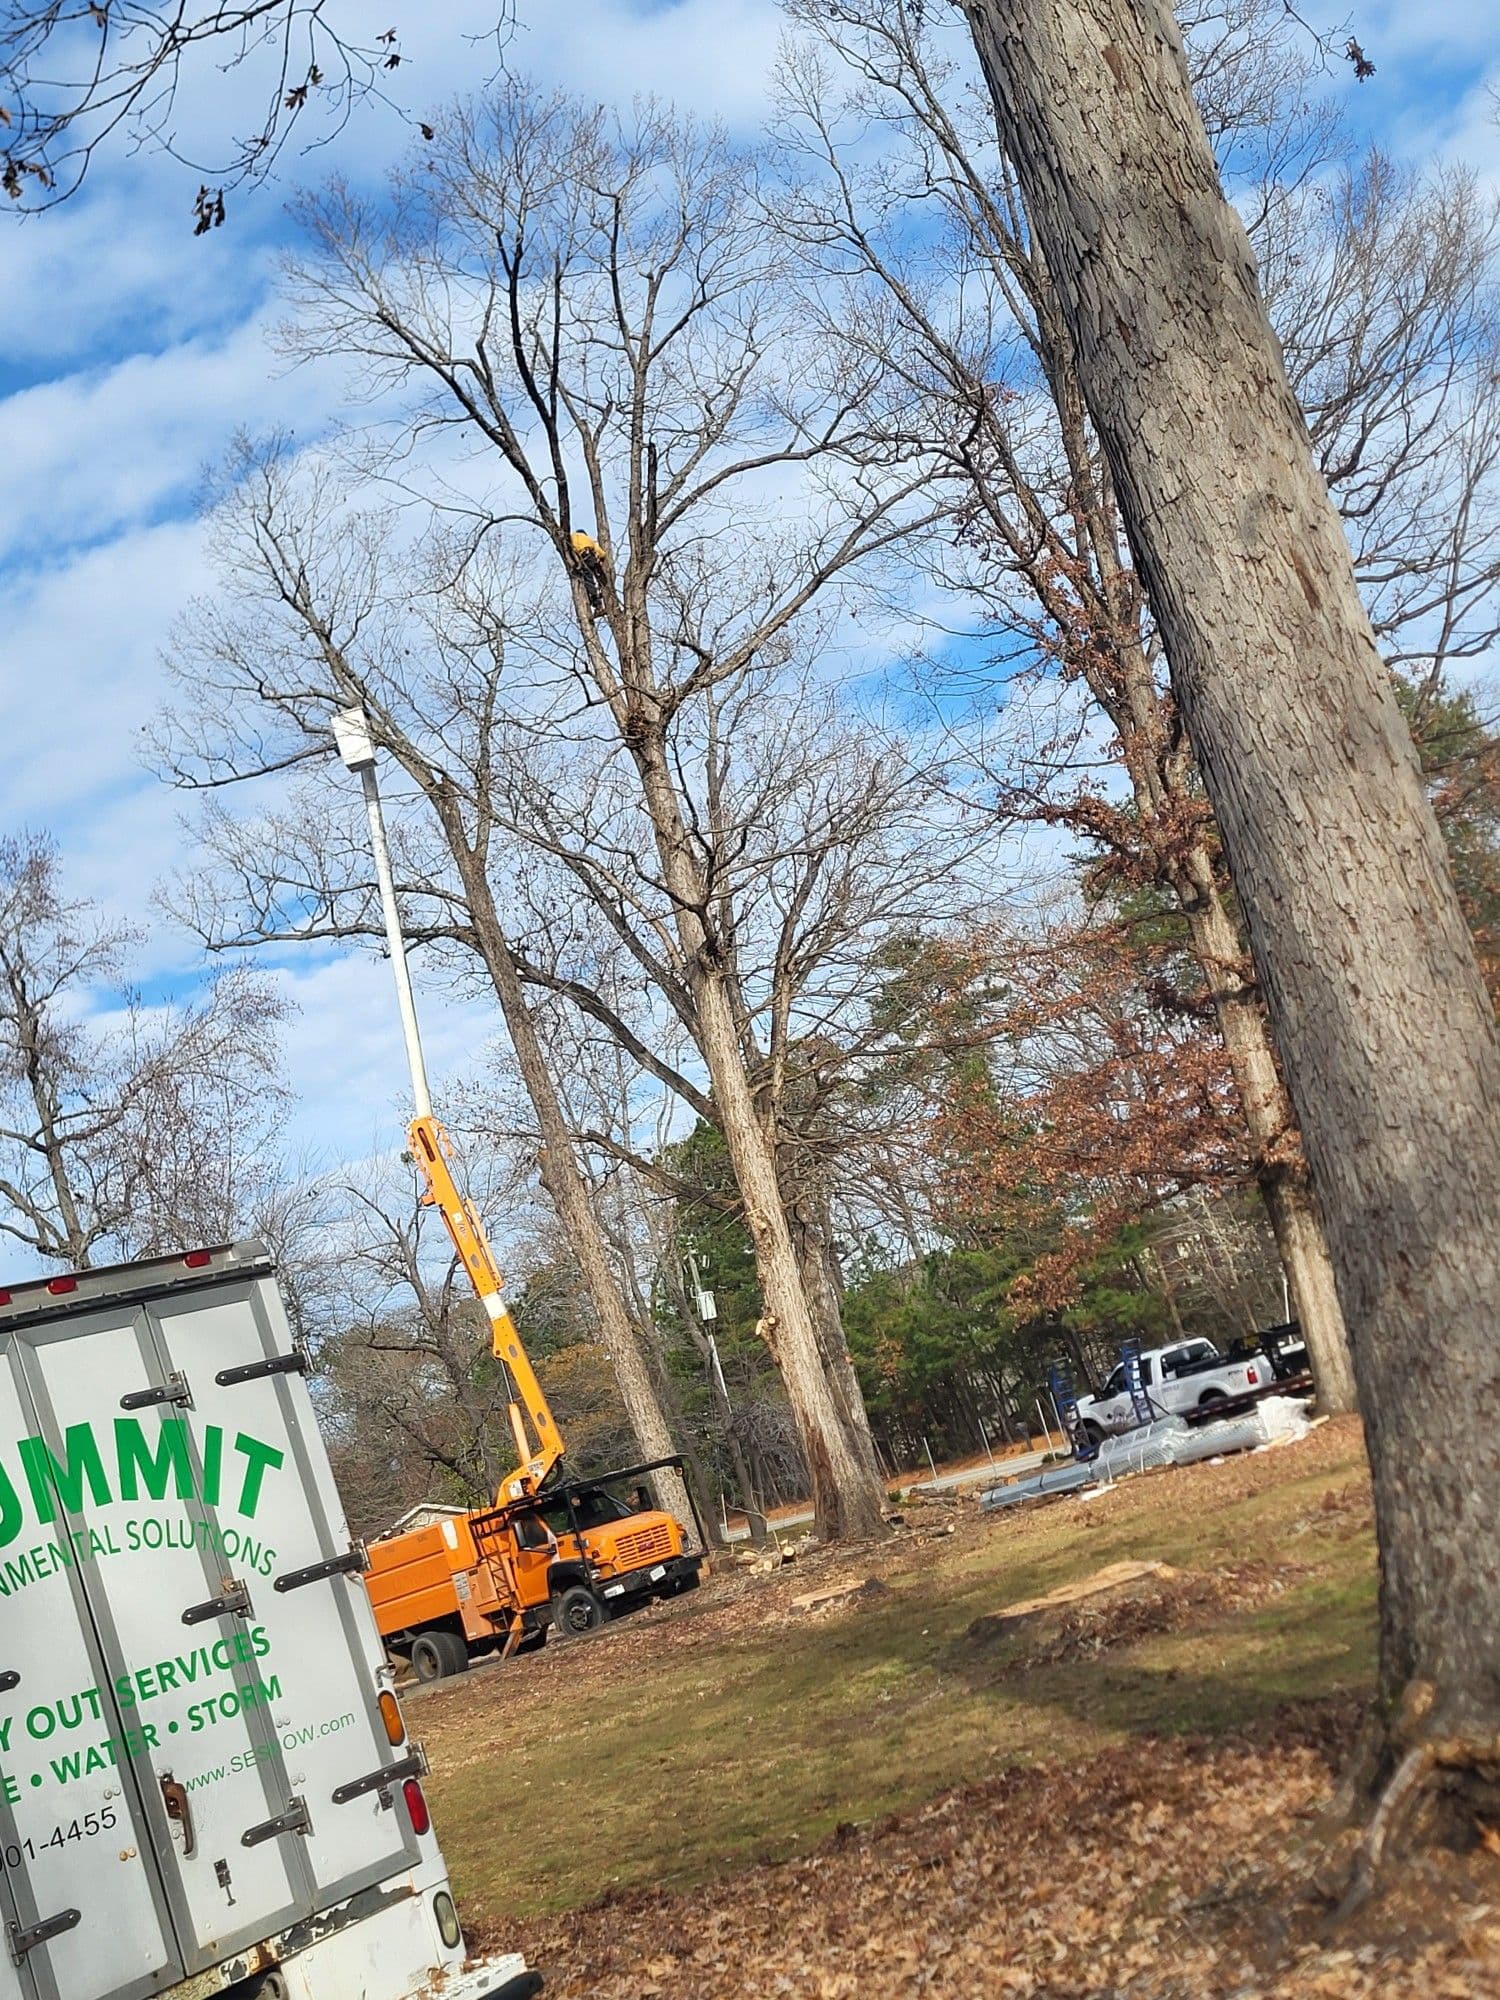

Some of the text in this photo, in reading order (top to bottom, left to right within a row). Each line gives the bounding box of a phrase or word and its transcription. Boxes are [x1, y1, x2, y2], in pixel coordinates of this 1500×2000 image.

[126, 1518, 277, 1577] SOLUTIONS
[26, 1688, 101, 1740] OUT
[116, 1626, 271, 1709] SERVICES
[0, 1674, 283, 1808] E WATER STORM
[0, 1806, 117, 1870] 01-4455
